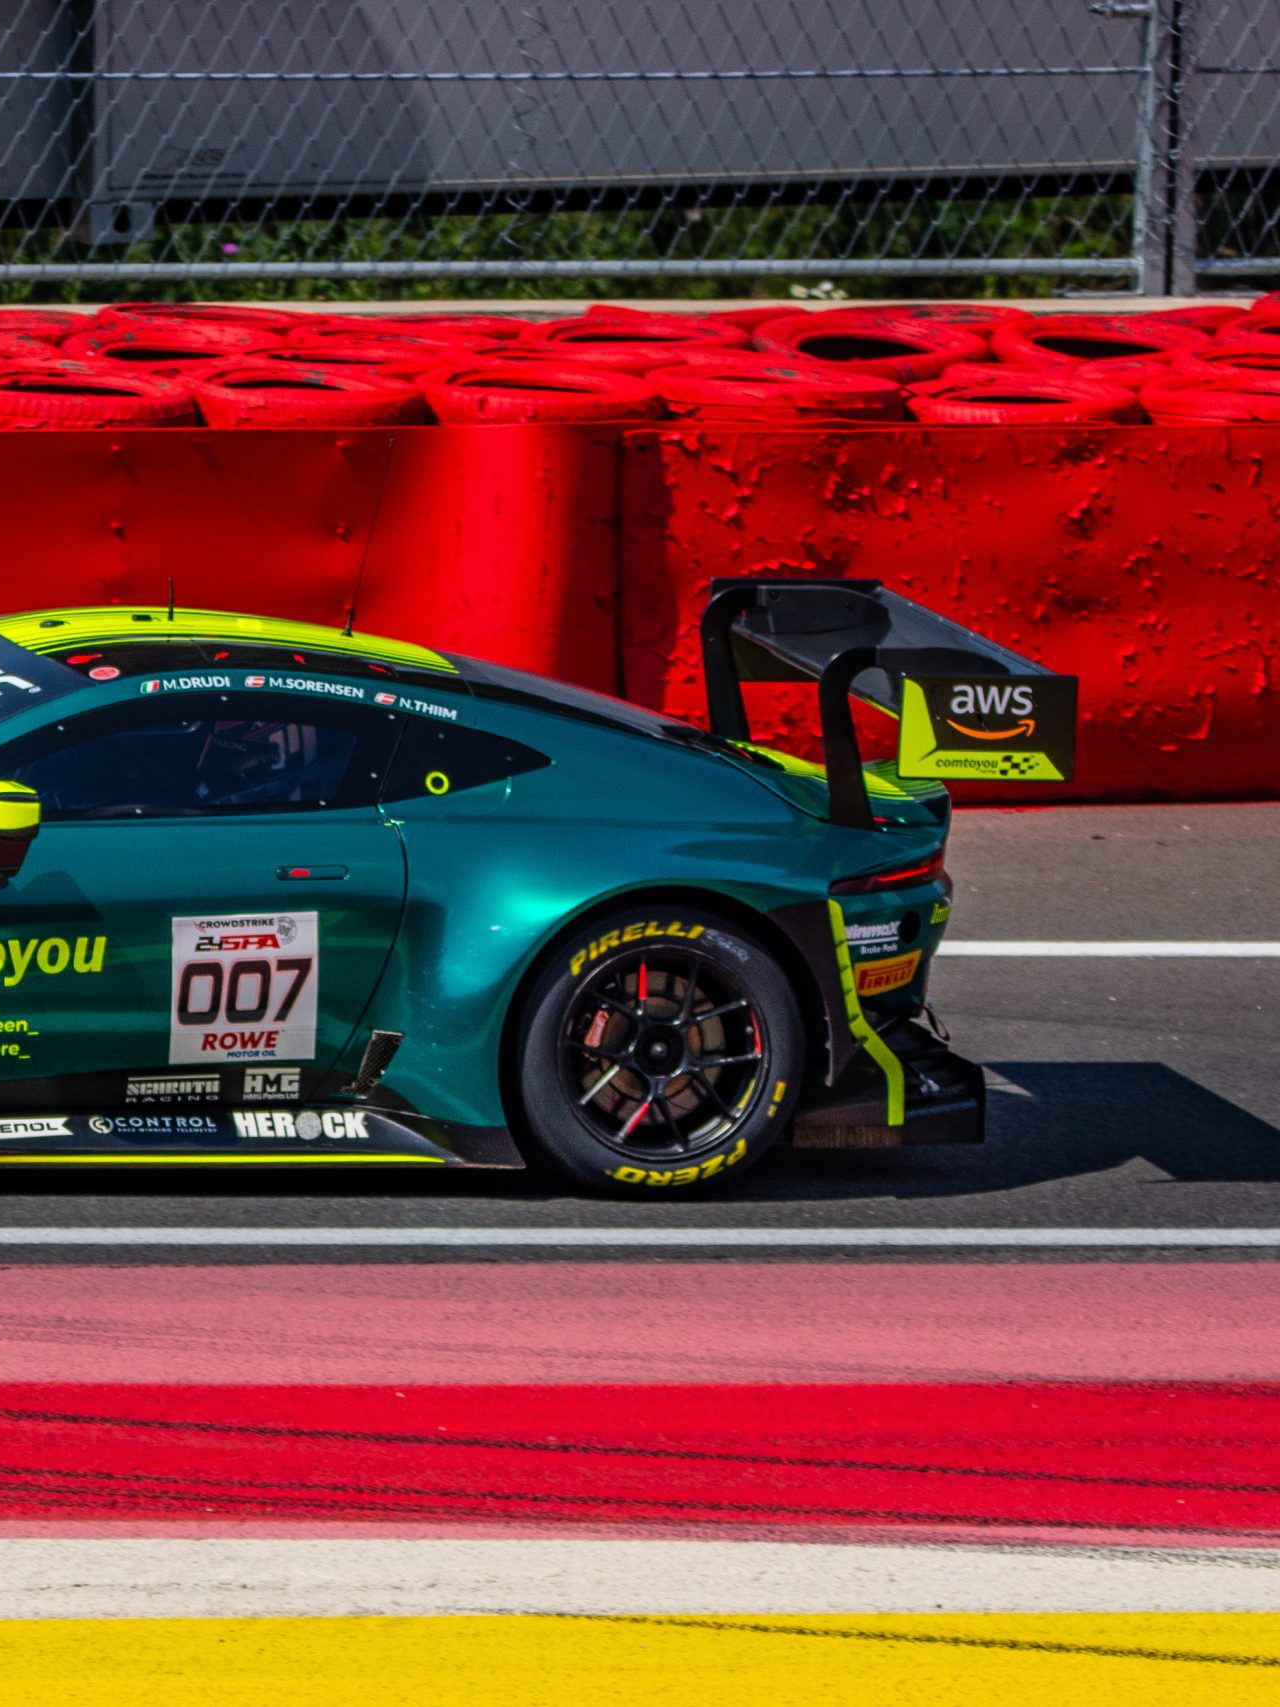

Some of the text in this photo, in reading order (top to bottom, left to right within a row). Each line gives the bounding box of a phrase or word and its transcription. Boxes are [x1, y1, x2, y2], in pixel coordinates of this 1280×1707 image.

[163, 675, 231, 691] M.DRUDI
[269, 677, 365, 699] M.SORENSEN
[399, 697, 458, 721] N.THIIM
[950, 684, 1033, 716] aws
[936, 757, 999, 771] comtoyou
[200, 918, 275, 929] CROWDSTRIKE
[570, 921, 705, 976] PIRELLI
[858, 958, 917, 991] PIRELLI
[177, 957, 313, 1026] 007
[201, 1030, 280, 1051] ROWE
[244, 1068, 300, 1093] HMG
[125, 1095, 219, 1103] RACING
[115, 1116, 216, 1128] CONTROL
[612, 1154, 726, 1187] ZERO
